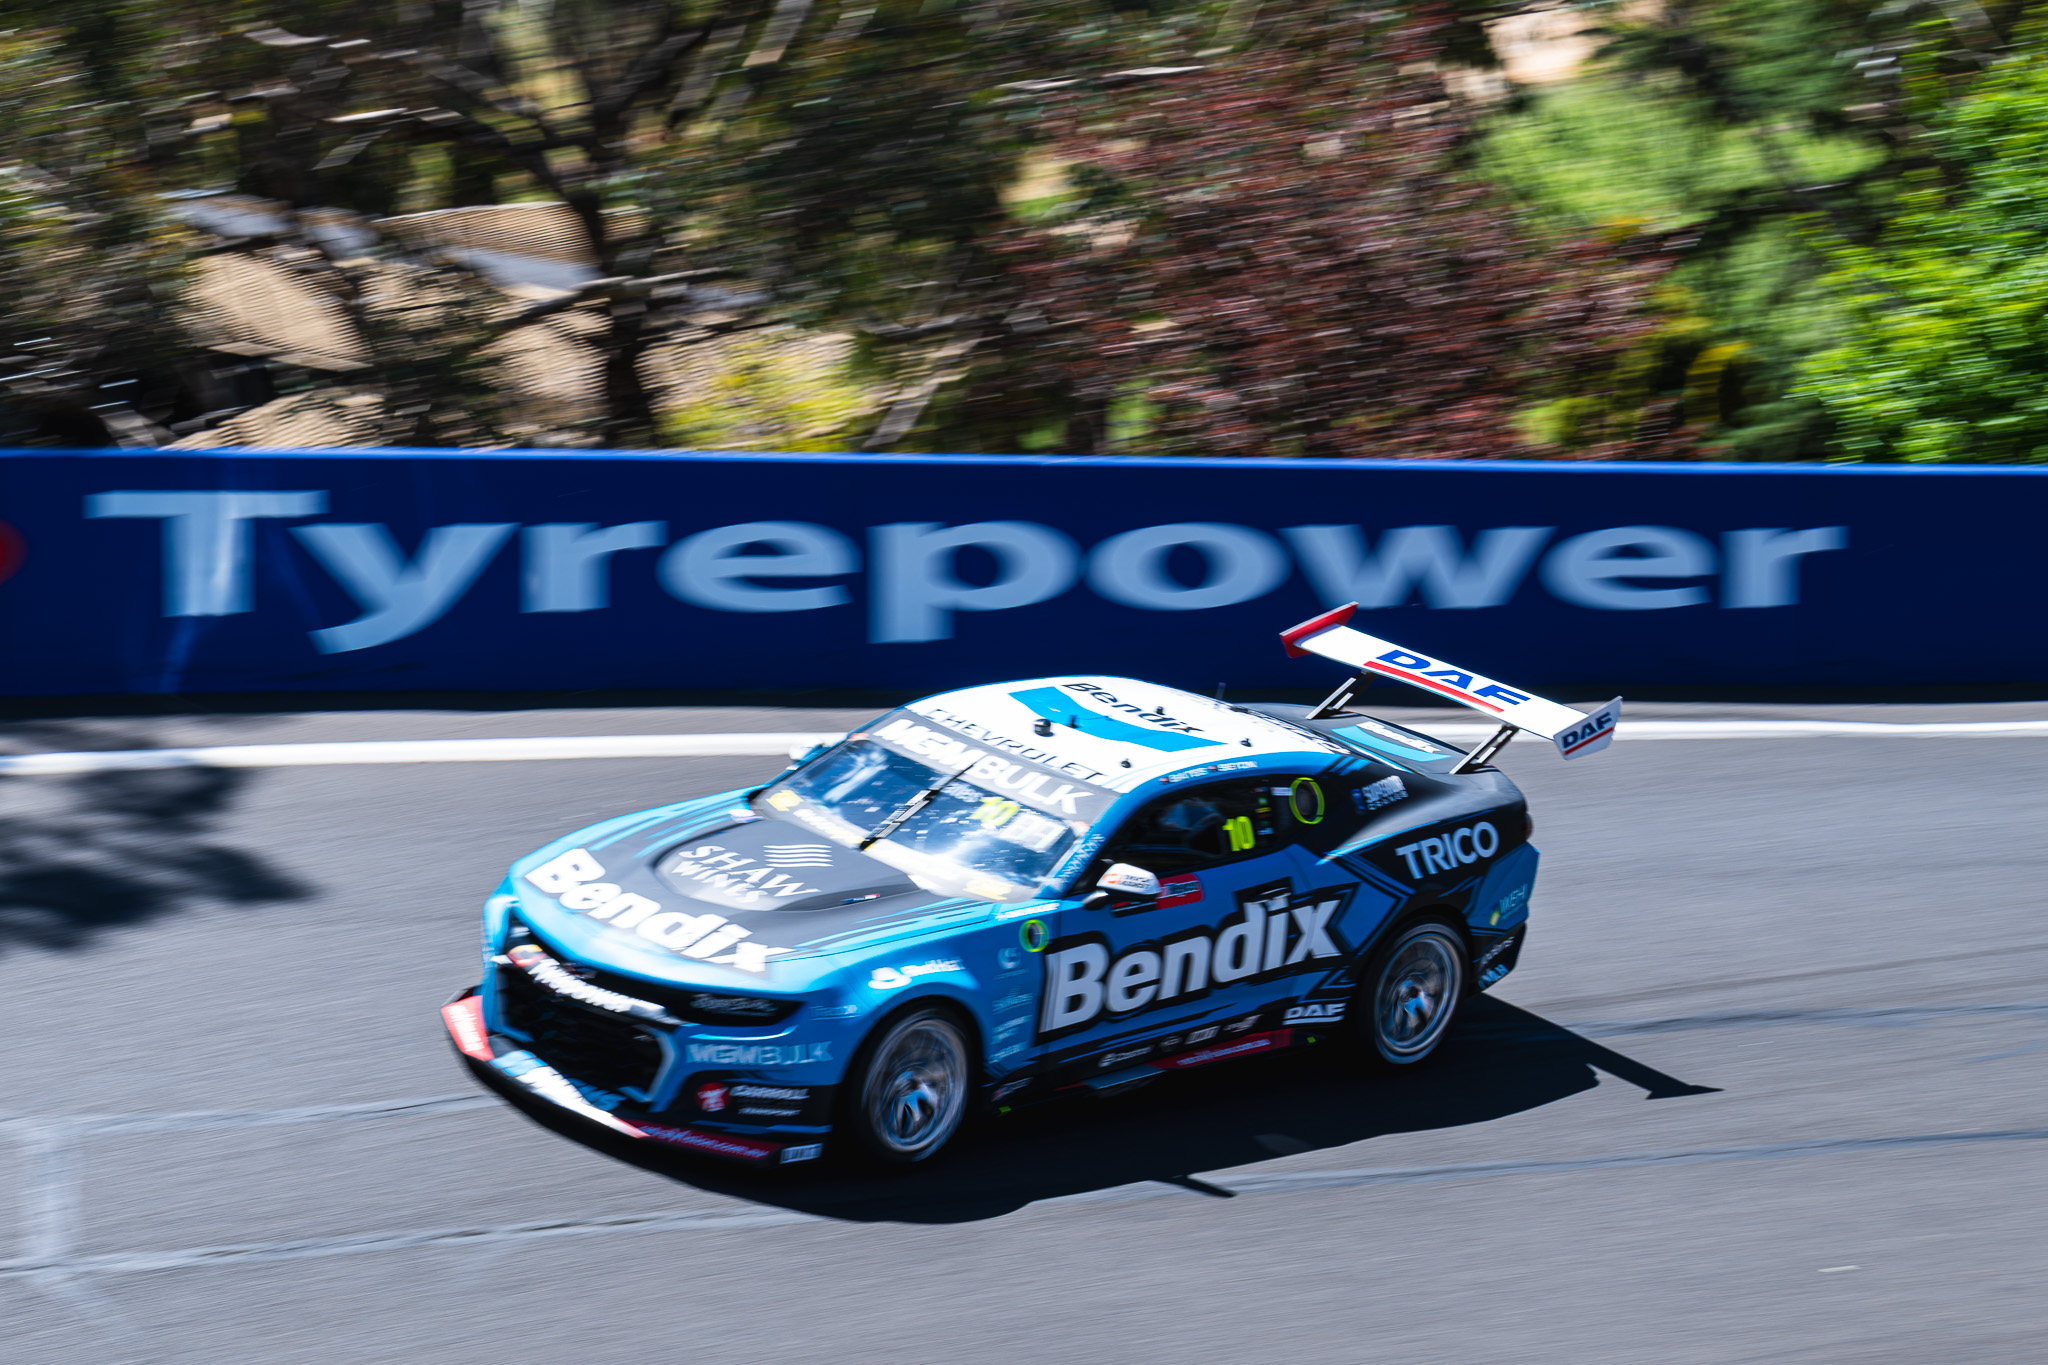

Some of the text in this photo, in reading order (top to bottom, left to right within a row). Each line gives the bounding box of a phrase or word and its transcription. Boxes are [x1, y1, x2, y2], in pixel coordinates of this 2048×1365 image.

[84, 490, 1849, 653] Tyrepower
[1376, 649, 1530, 706] DAF
[1061, 682, 1205, 734] Bendix
[1561, 711, 1613, 749] DAF
[921, 708, 1108, 780] CHEVROLET
[1222, 815, 1256, 851] 10
[1394, 821, 1499, 879] TRICO
[678, 845, 822, 897] SHAW
[524, 848, 798, 973] Bendix
[1038, 889, 1343, 1034] Bendix
[1282, 1002, 1347, 1020] DAF
